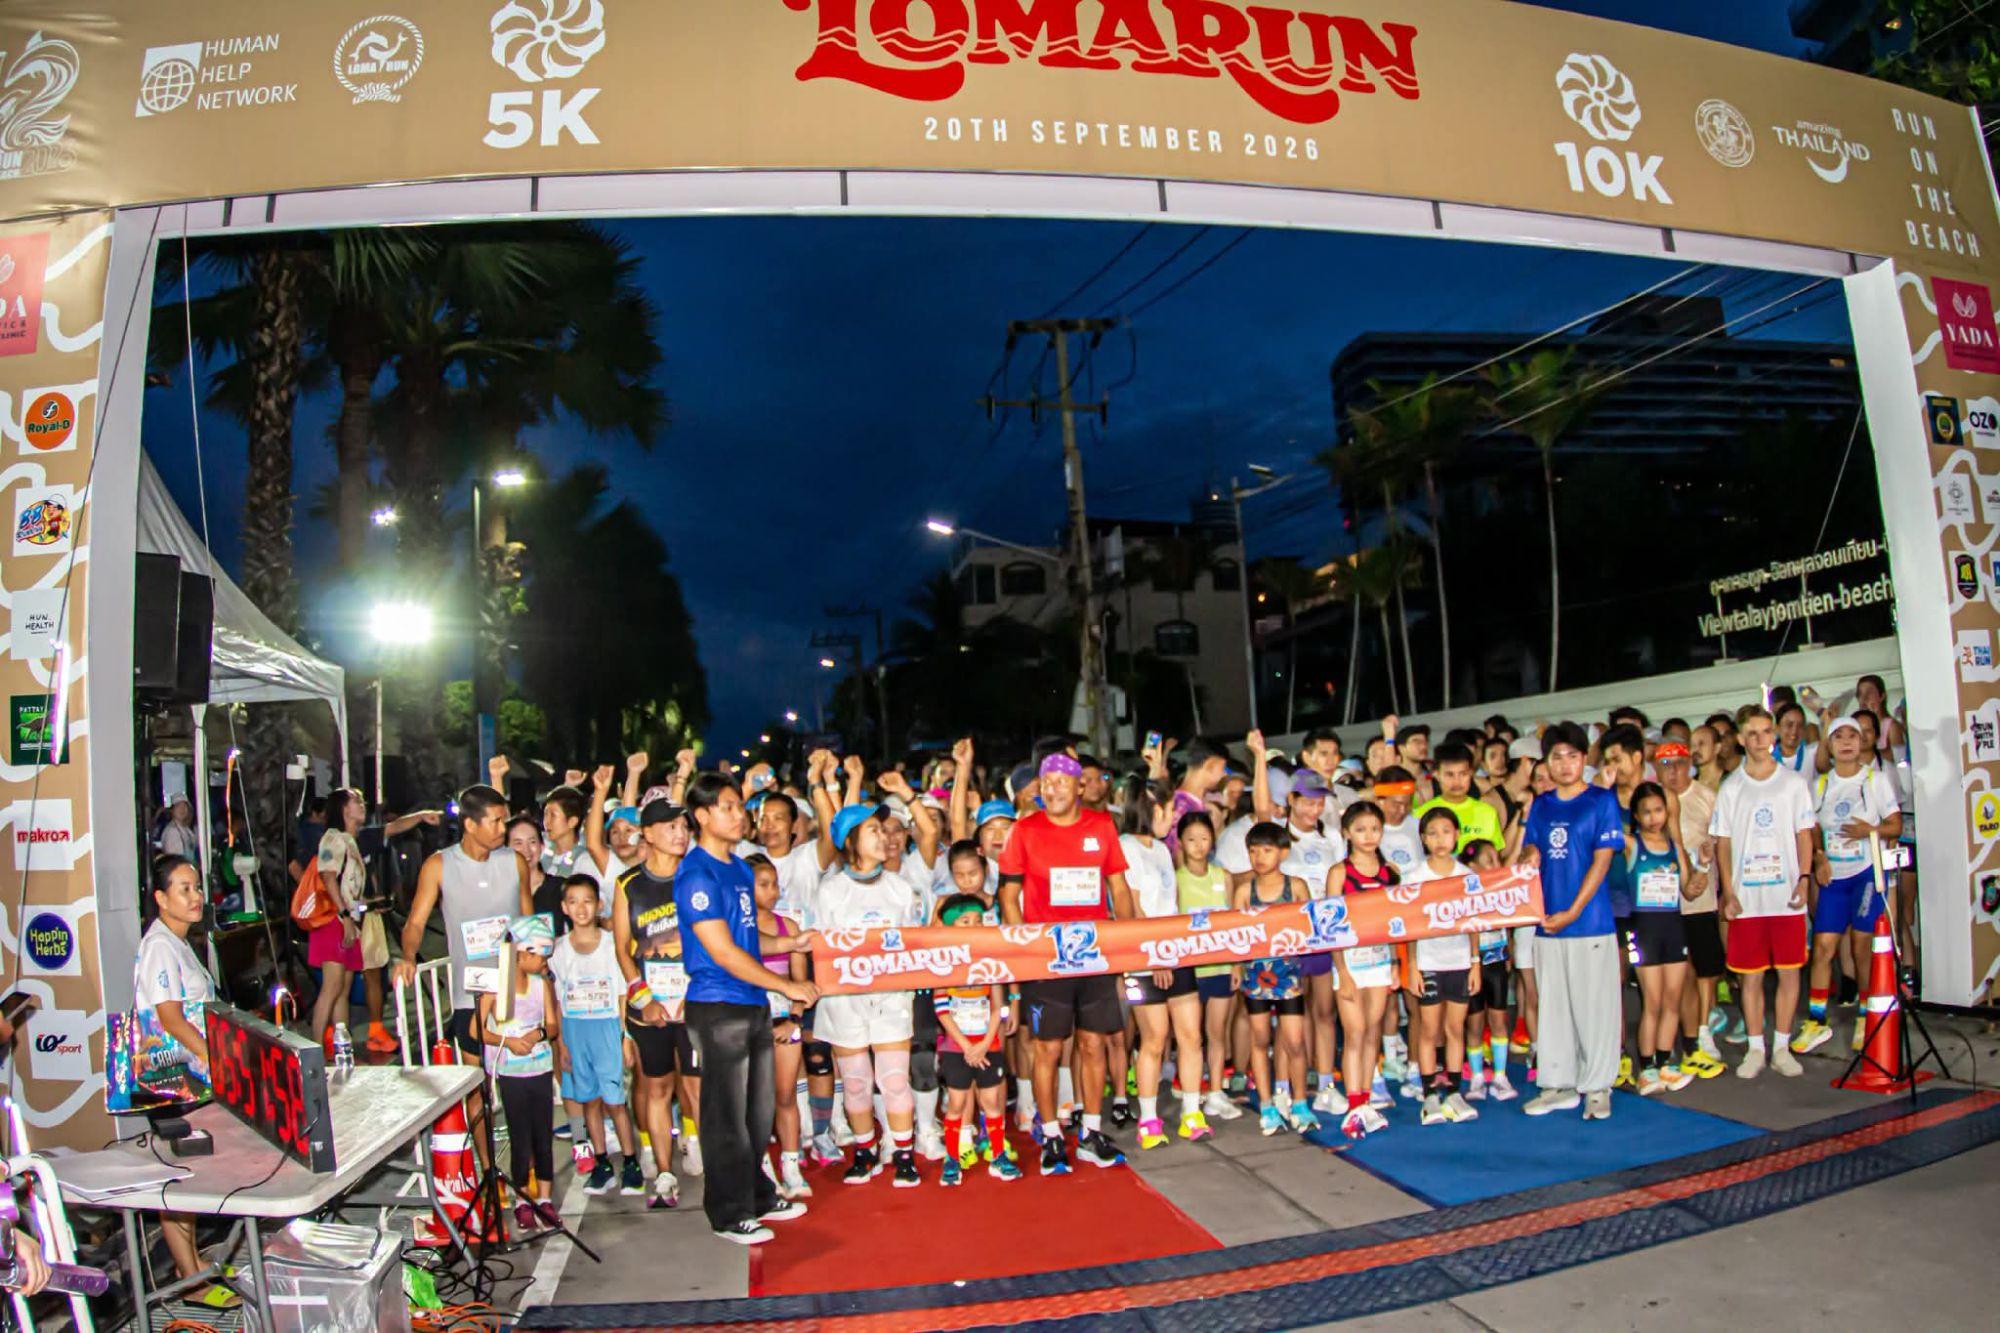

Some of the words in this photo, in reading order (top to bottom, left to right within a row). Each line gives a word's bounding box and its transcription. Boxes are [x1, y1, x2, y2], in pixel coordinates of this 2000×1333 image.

[205, 33, 280, 58] HUMAN
[784, 0, 1420, 123] LOMARUN
[200, 62, 252, 83] HELP
[196, 83, 298, 110] NETWORK
[481, 87, 602, 149] 5K
[1891, 108, 1937, 141] RUN
[923, 116, 1008, 143] 20TH
[1031, 119, 1223, 154] SEPTEMBER
[1243, 132, 1320, 161] 2026
[1771, 125, 1870, 161] THAILAND
[1553, 141, 1675, 205] 10K
[1910, 147, 1938, 175] ON
[1911, 183, 1956, 215] THE
[1905, 220, 1980, 258] BEACH
[28, 420, 71, 433] Royal-D
[16, 827, 59, 844] makro
[1423, 884, 1531, 930] LOMARUN
[30, 928, 68, 944] Happin
[36, 941, 67, 957] Herbs
[1140, 922, 1267, 968] LOMARUN
[832, 943, 972, 986] LOMARUN
